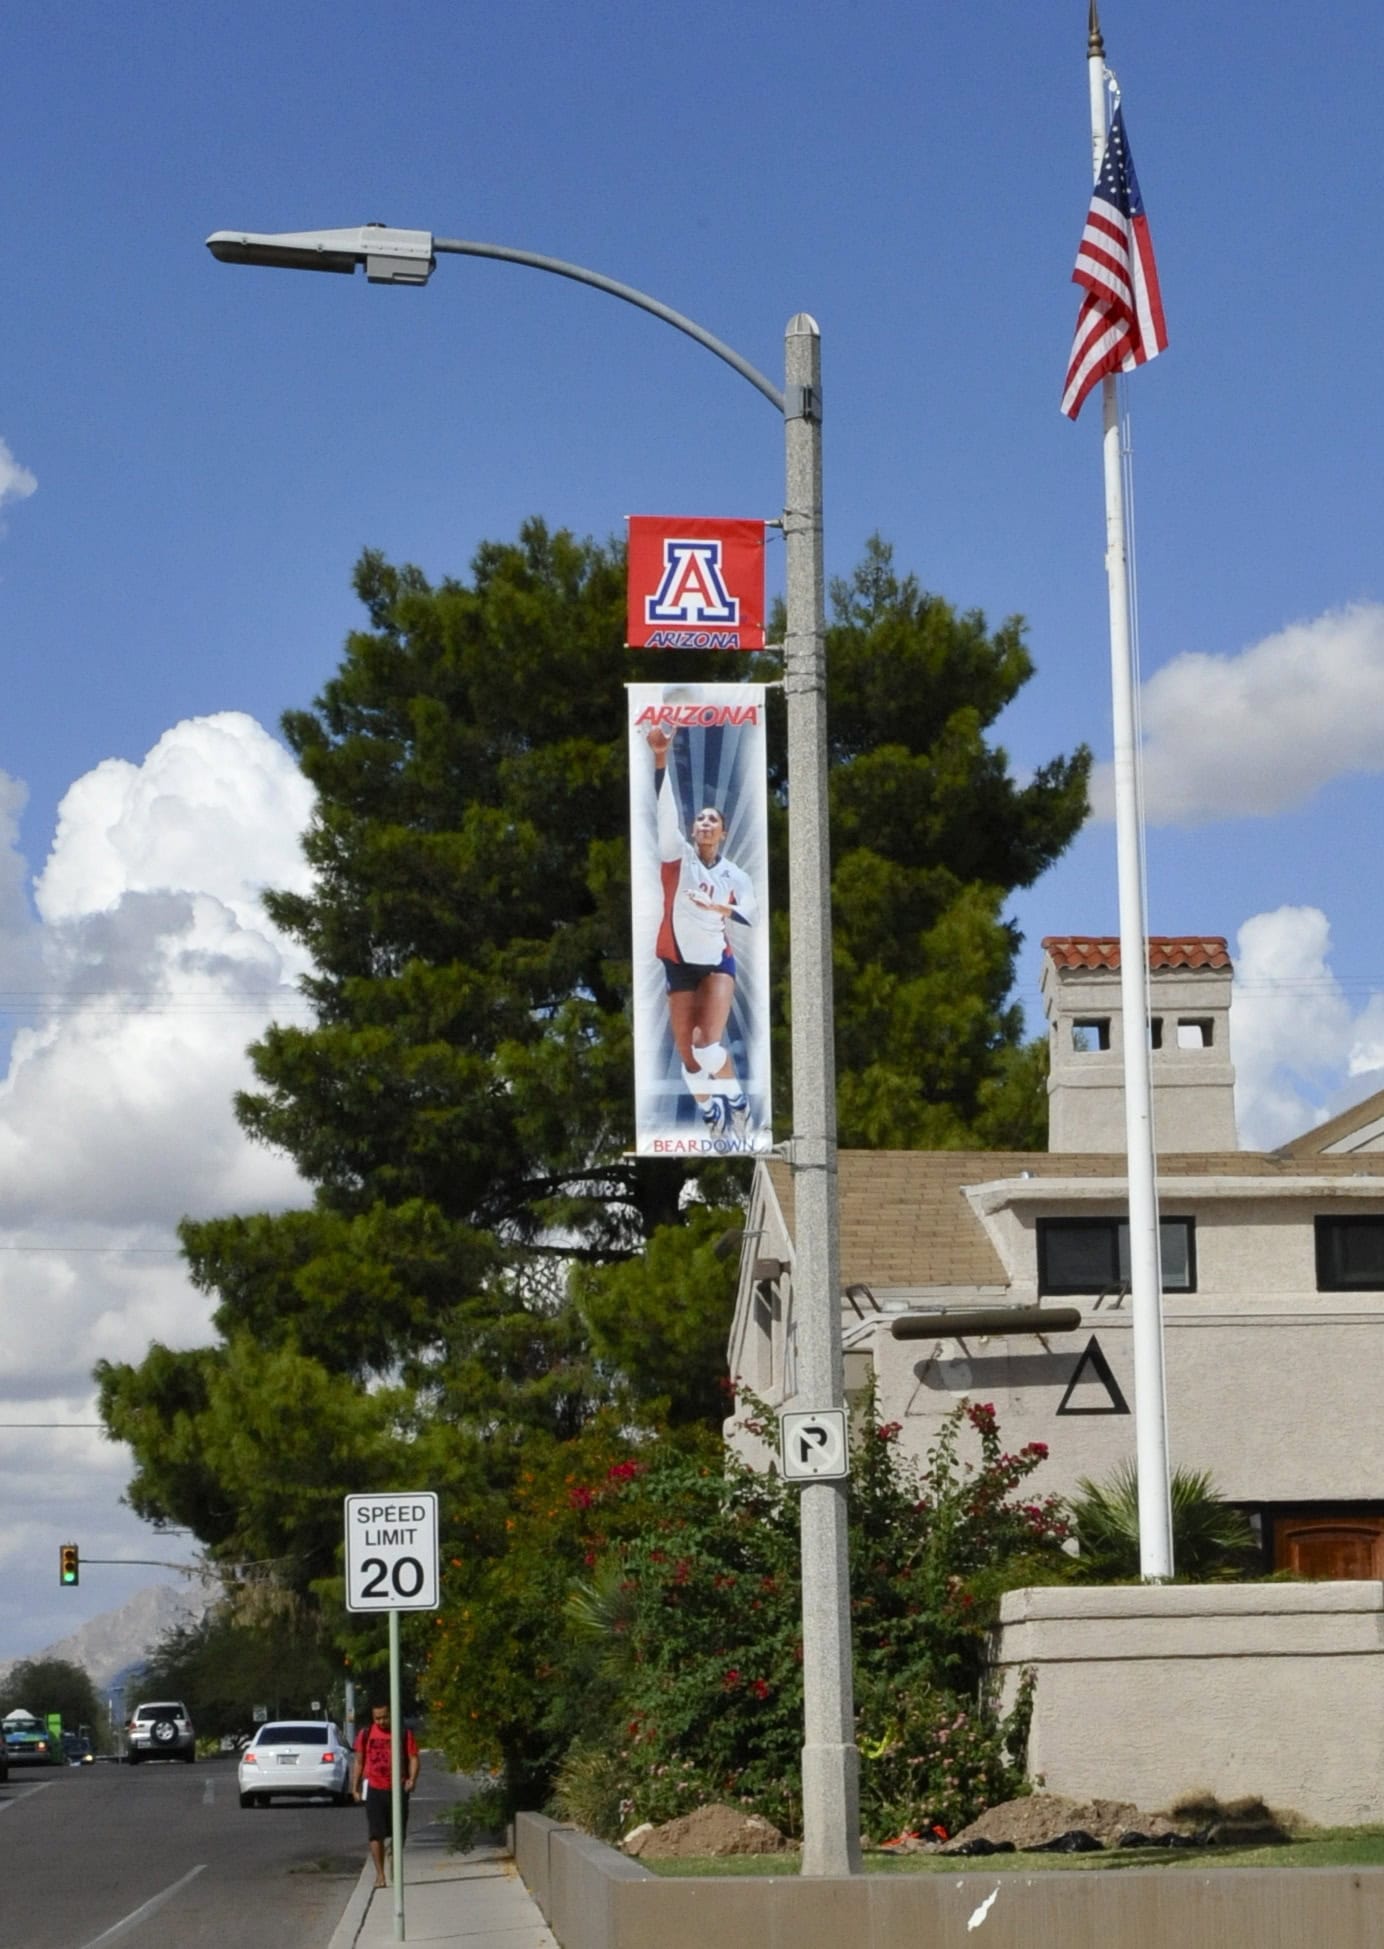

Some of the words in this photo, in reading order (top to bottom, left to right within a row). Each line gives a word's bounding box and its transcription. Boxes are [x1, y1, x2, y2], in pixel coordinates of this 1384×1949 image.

[645, 538, 740, 627] A
[645, 631, 740, 649] ARIZONA
[635, 705, 757, 726] ARIZONA
[800, 1427, 828, 1463] P
[357, 1506, 426, 1524] SPEED
[365, 1528, 418, 1546] LIMIT
[360, 1556, 425, 1598] 20
